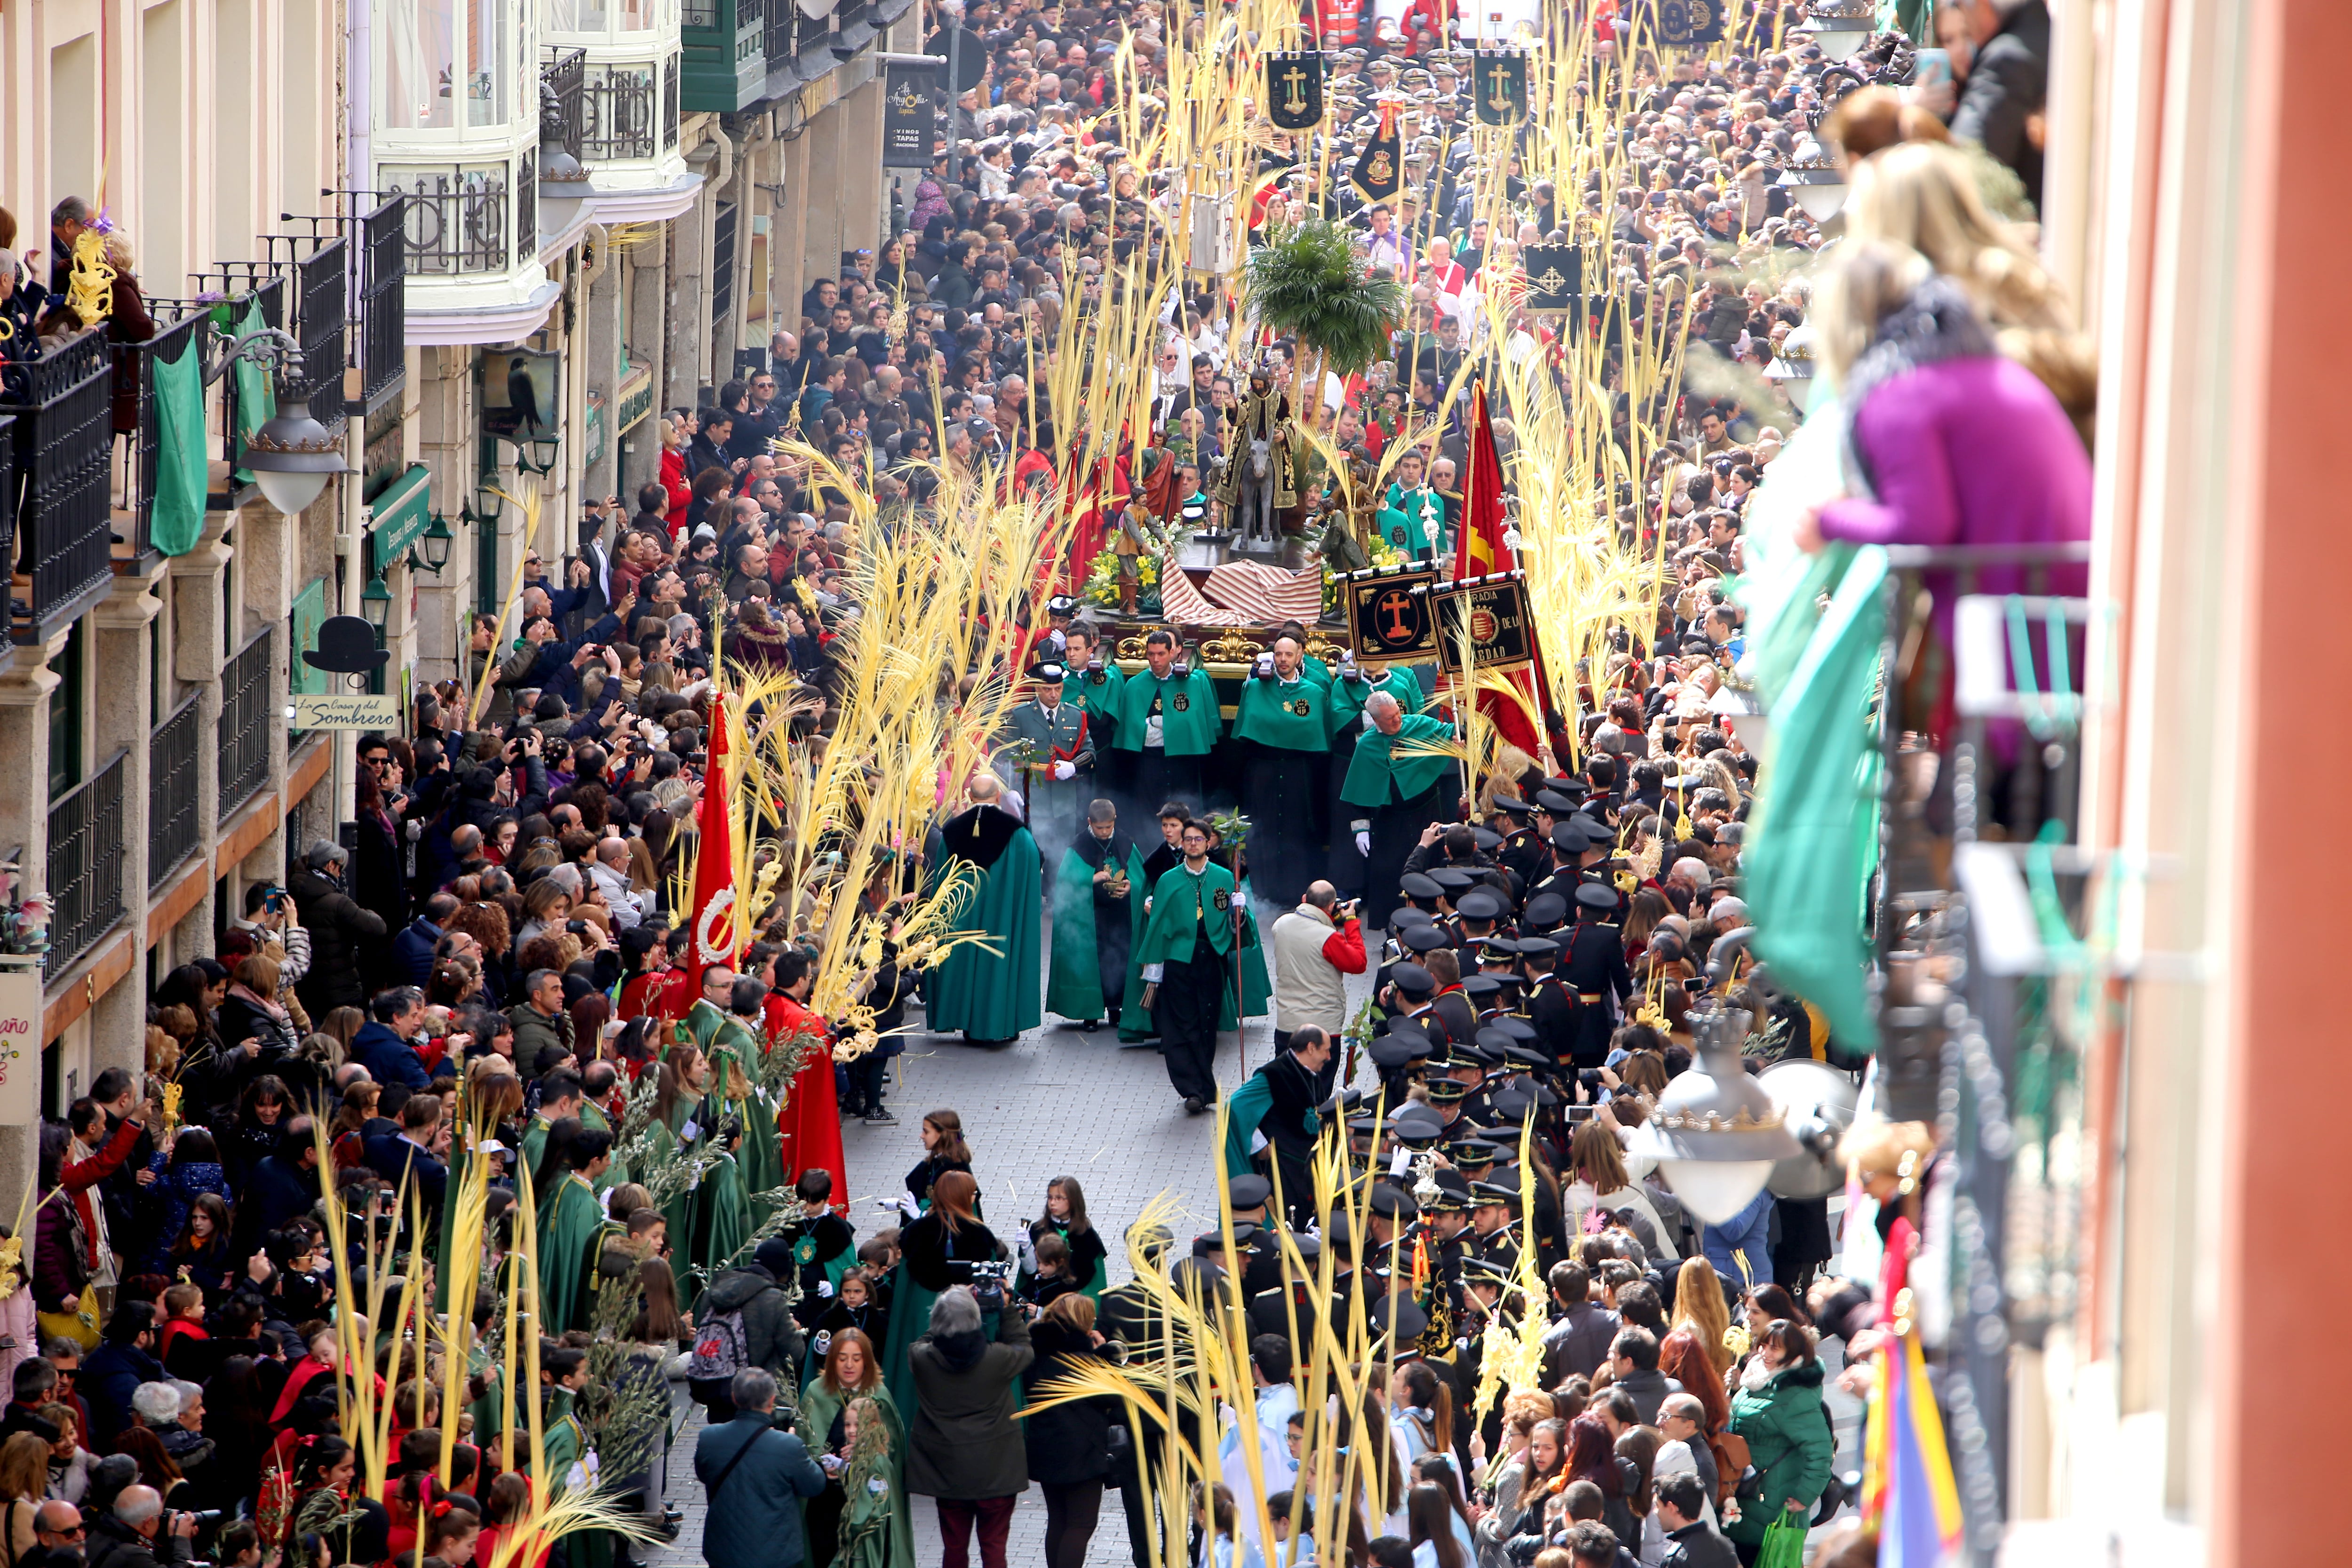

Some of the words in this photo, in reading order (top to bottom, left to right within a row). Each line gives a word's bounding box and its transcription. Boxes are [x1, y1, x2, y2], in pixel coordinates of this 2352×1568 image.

[901, 81, 911, 96] La
[1502, 617, 1511, 629] DE
[298, 698, 313, 709] La
[331, 699, 355, 709] Casa
[363, 700, 380, 709] del
[311, 703, 393, 725] Sombrero
